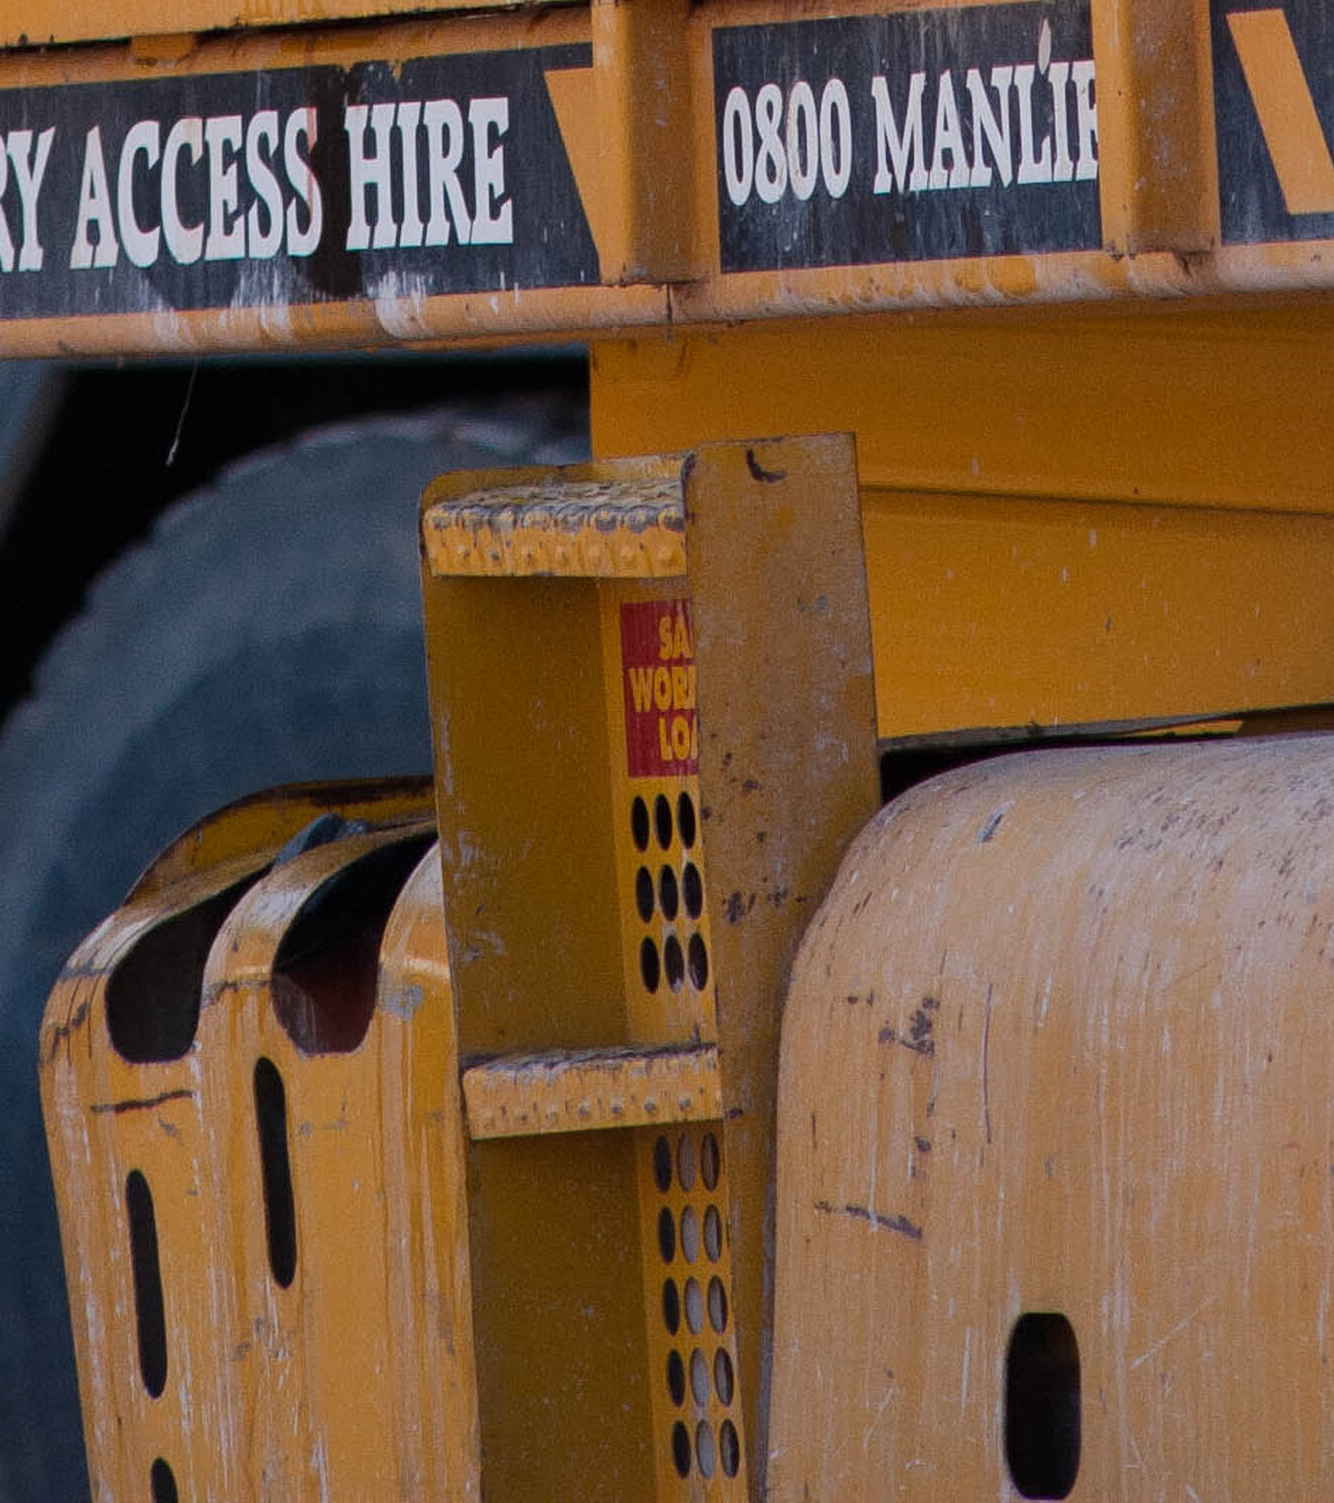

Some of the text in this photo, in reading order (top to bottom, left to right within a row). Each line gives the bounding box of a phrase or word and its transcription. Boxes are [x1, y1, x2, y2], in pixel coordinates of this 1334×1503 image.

[69, 106, 323, 269] ACCESS
[344, 97, 513, 251] HIRE
[723, 60, 1099, 206] 0800 MANLIF
[658, 614, 694, 660] SA
